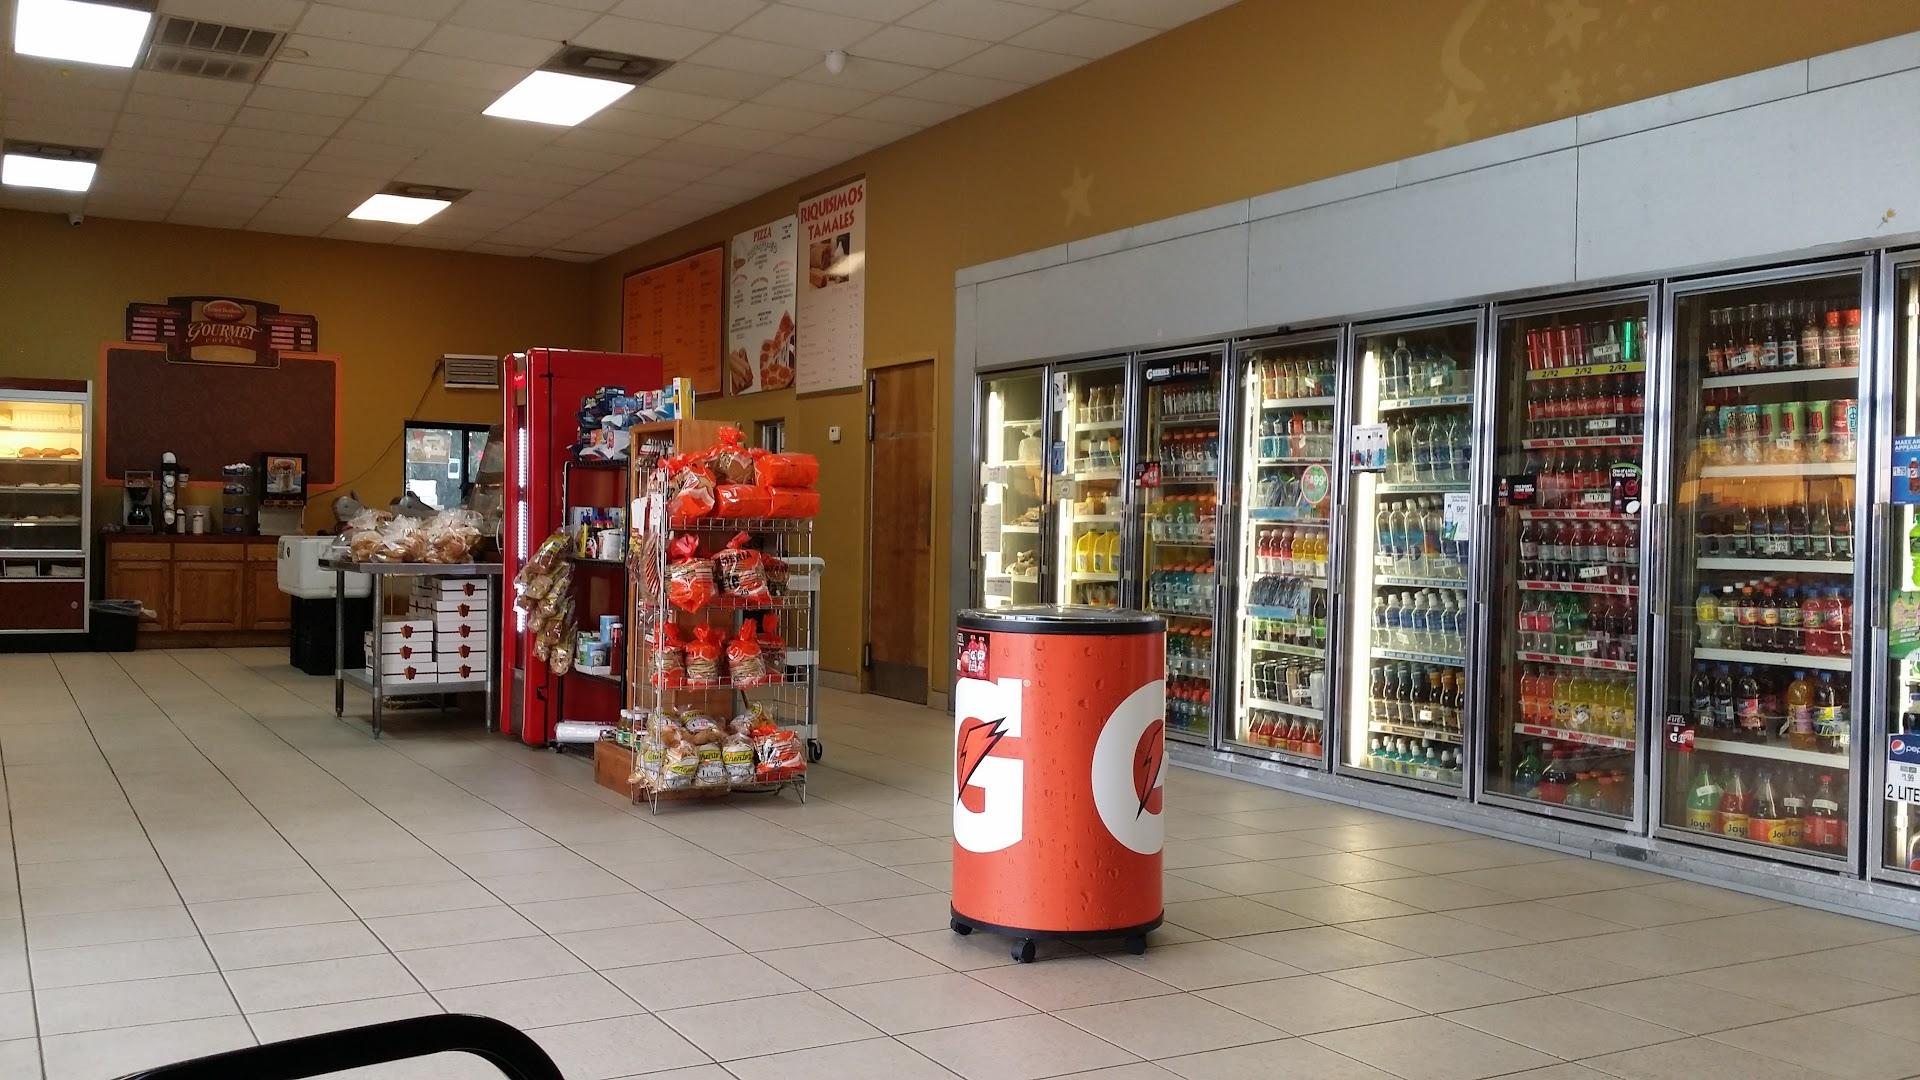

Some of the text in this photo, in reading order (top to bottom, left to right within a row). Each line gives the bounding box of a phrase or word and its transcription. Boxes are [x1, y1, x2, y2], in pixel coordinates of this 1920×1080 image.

[801, 184, 863, 224] RIQUISIMOS
[753, 226, 772, 242] PIZZA
[808, 209, 855, 240] TAMALES
[186, 321, 262, 343] GOURMET
[953, 676, 1023, 853] G
[1887, 784, 1894, 799] 2
